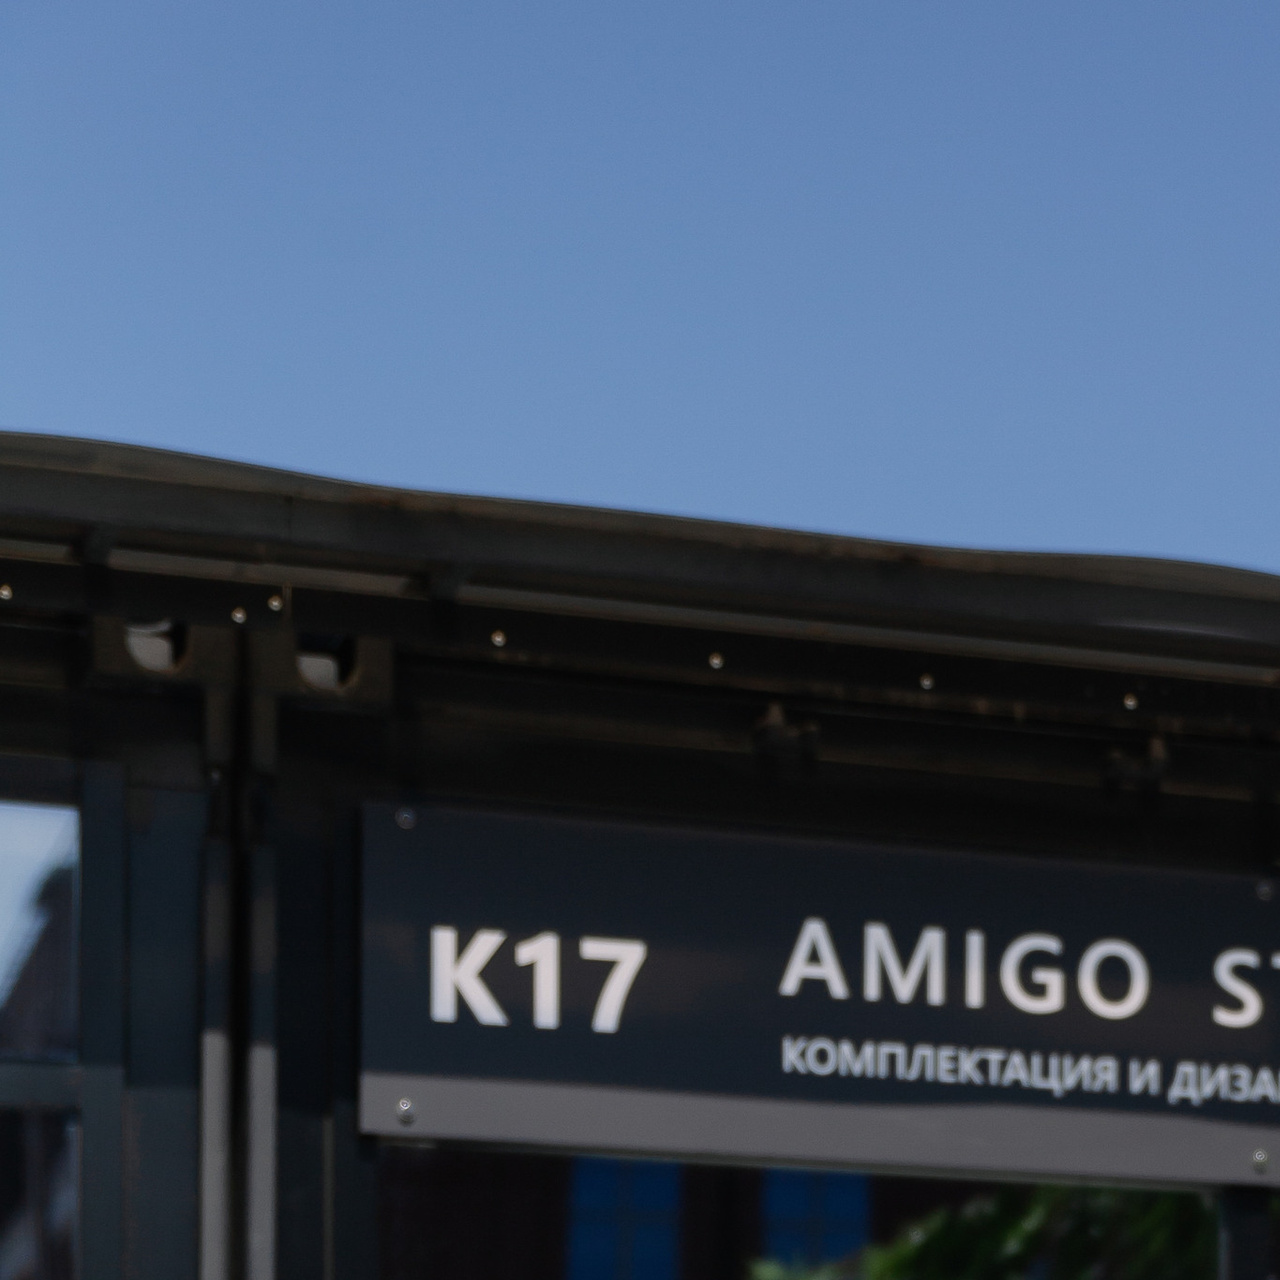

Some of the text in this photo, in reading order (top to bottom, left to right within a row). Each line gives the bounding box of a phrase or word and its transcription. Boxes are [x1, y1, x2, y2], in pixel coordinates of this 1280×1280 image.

[429, 924, 648, 1034] K17
[778, 916, 1151, 1020] AMIGO
[781, 1036, 1119, 1097] КОМПЛЕКТАЦИЯ
[1128, 1059, 1161, 1095] И
